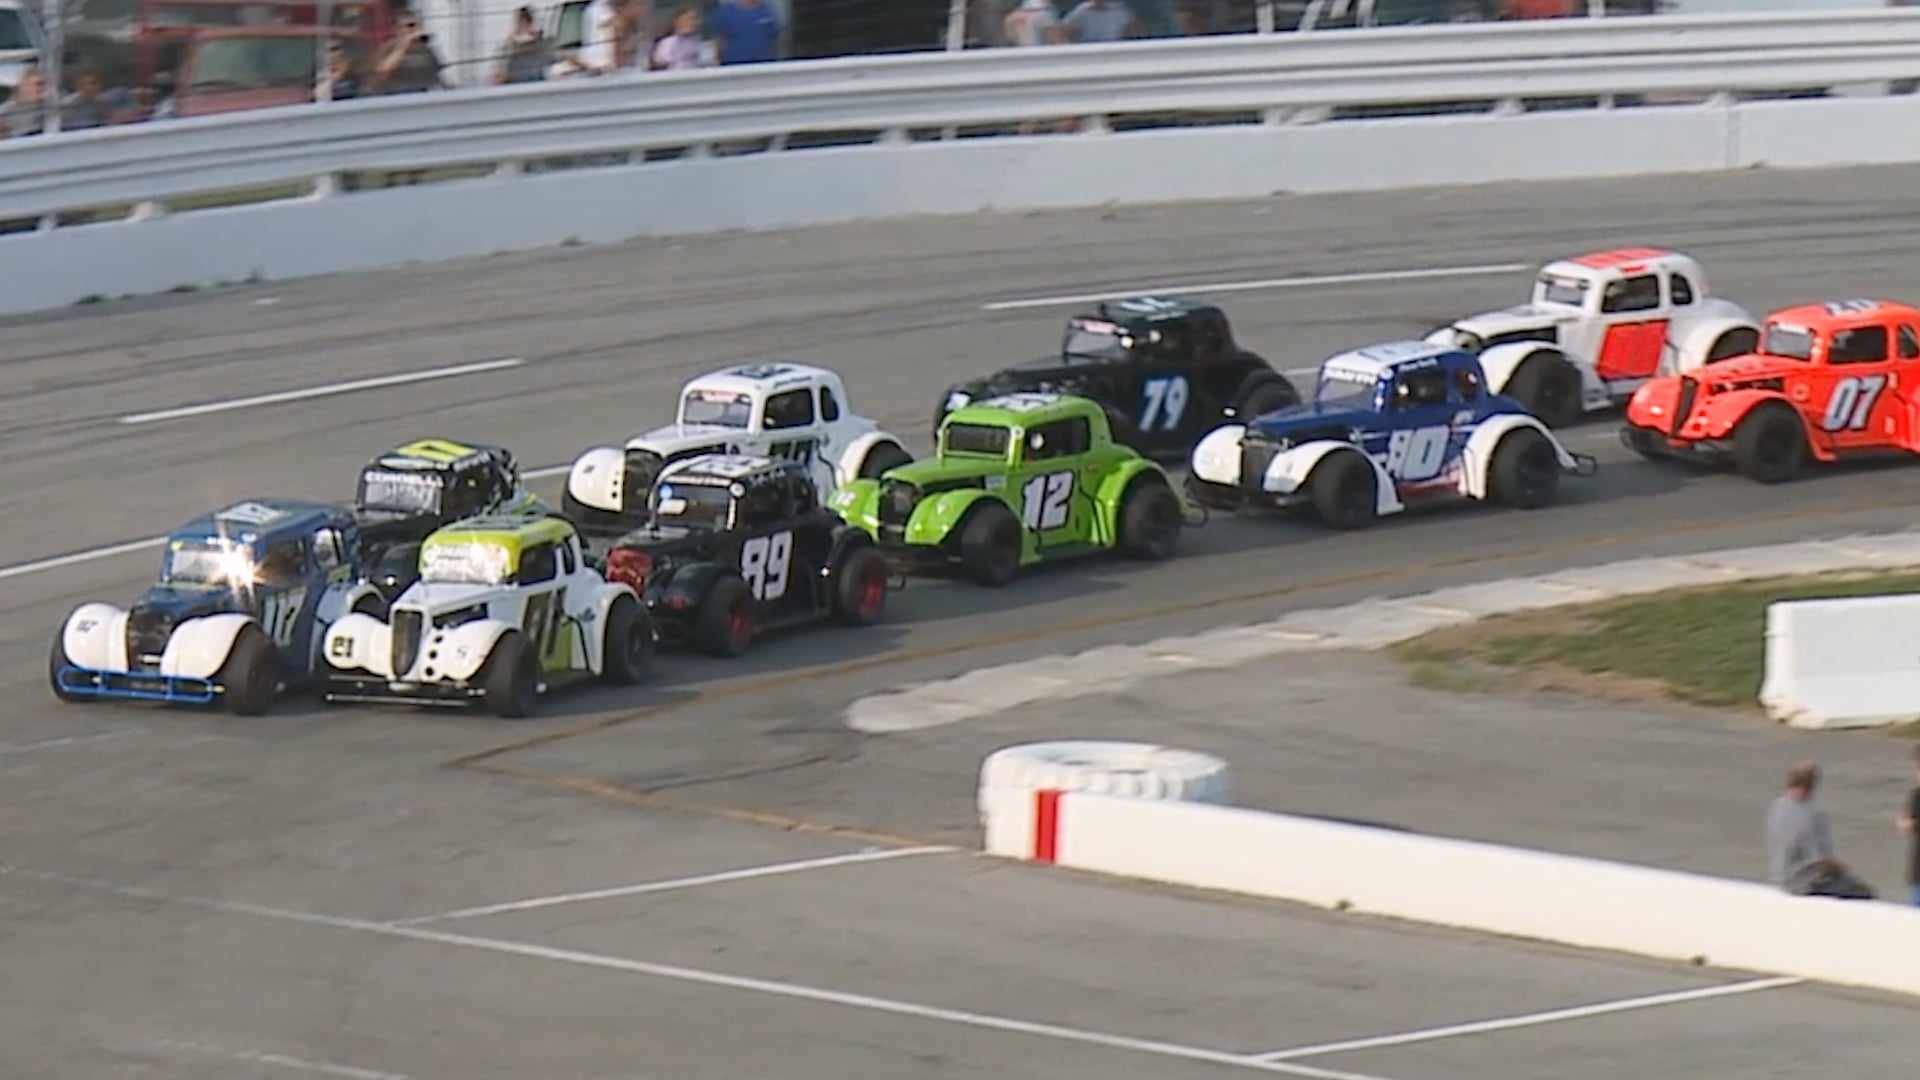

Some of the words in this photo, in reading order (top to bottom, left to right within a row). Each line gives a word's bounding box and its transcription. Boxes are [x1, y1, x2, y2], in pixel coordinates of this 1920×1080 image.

[1139, 375, 1189, 432] 79
[1822, 374, 1887, 431] 07
[1022, 471, 1075, 532] 12
[741, 531, 793, 600] 89
